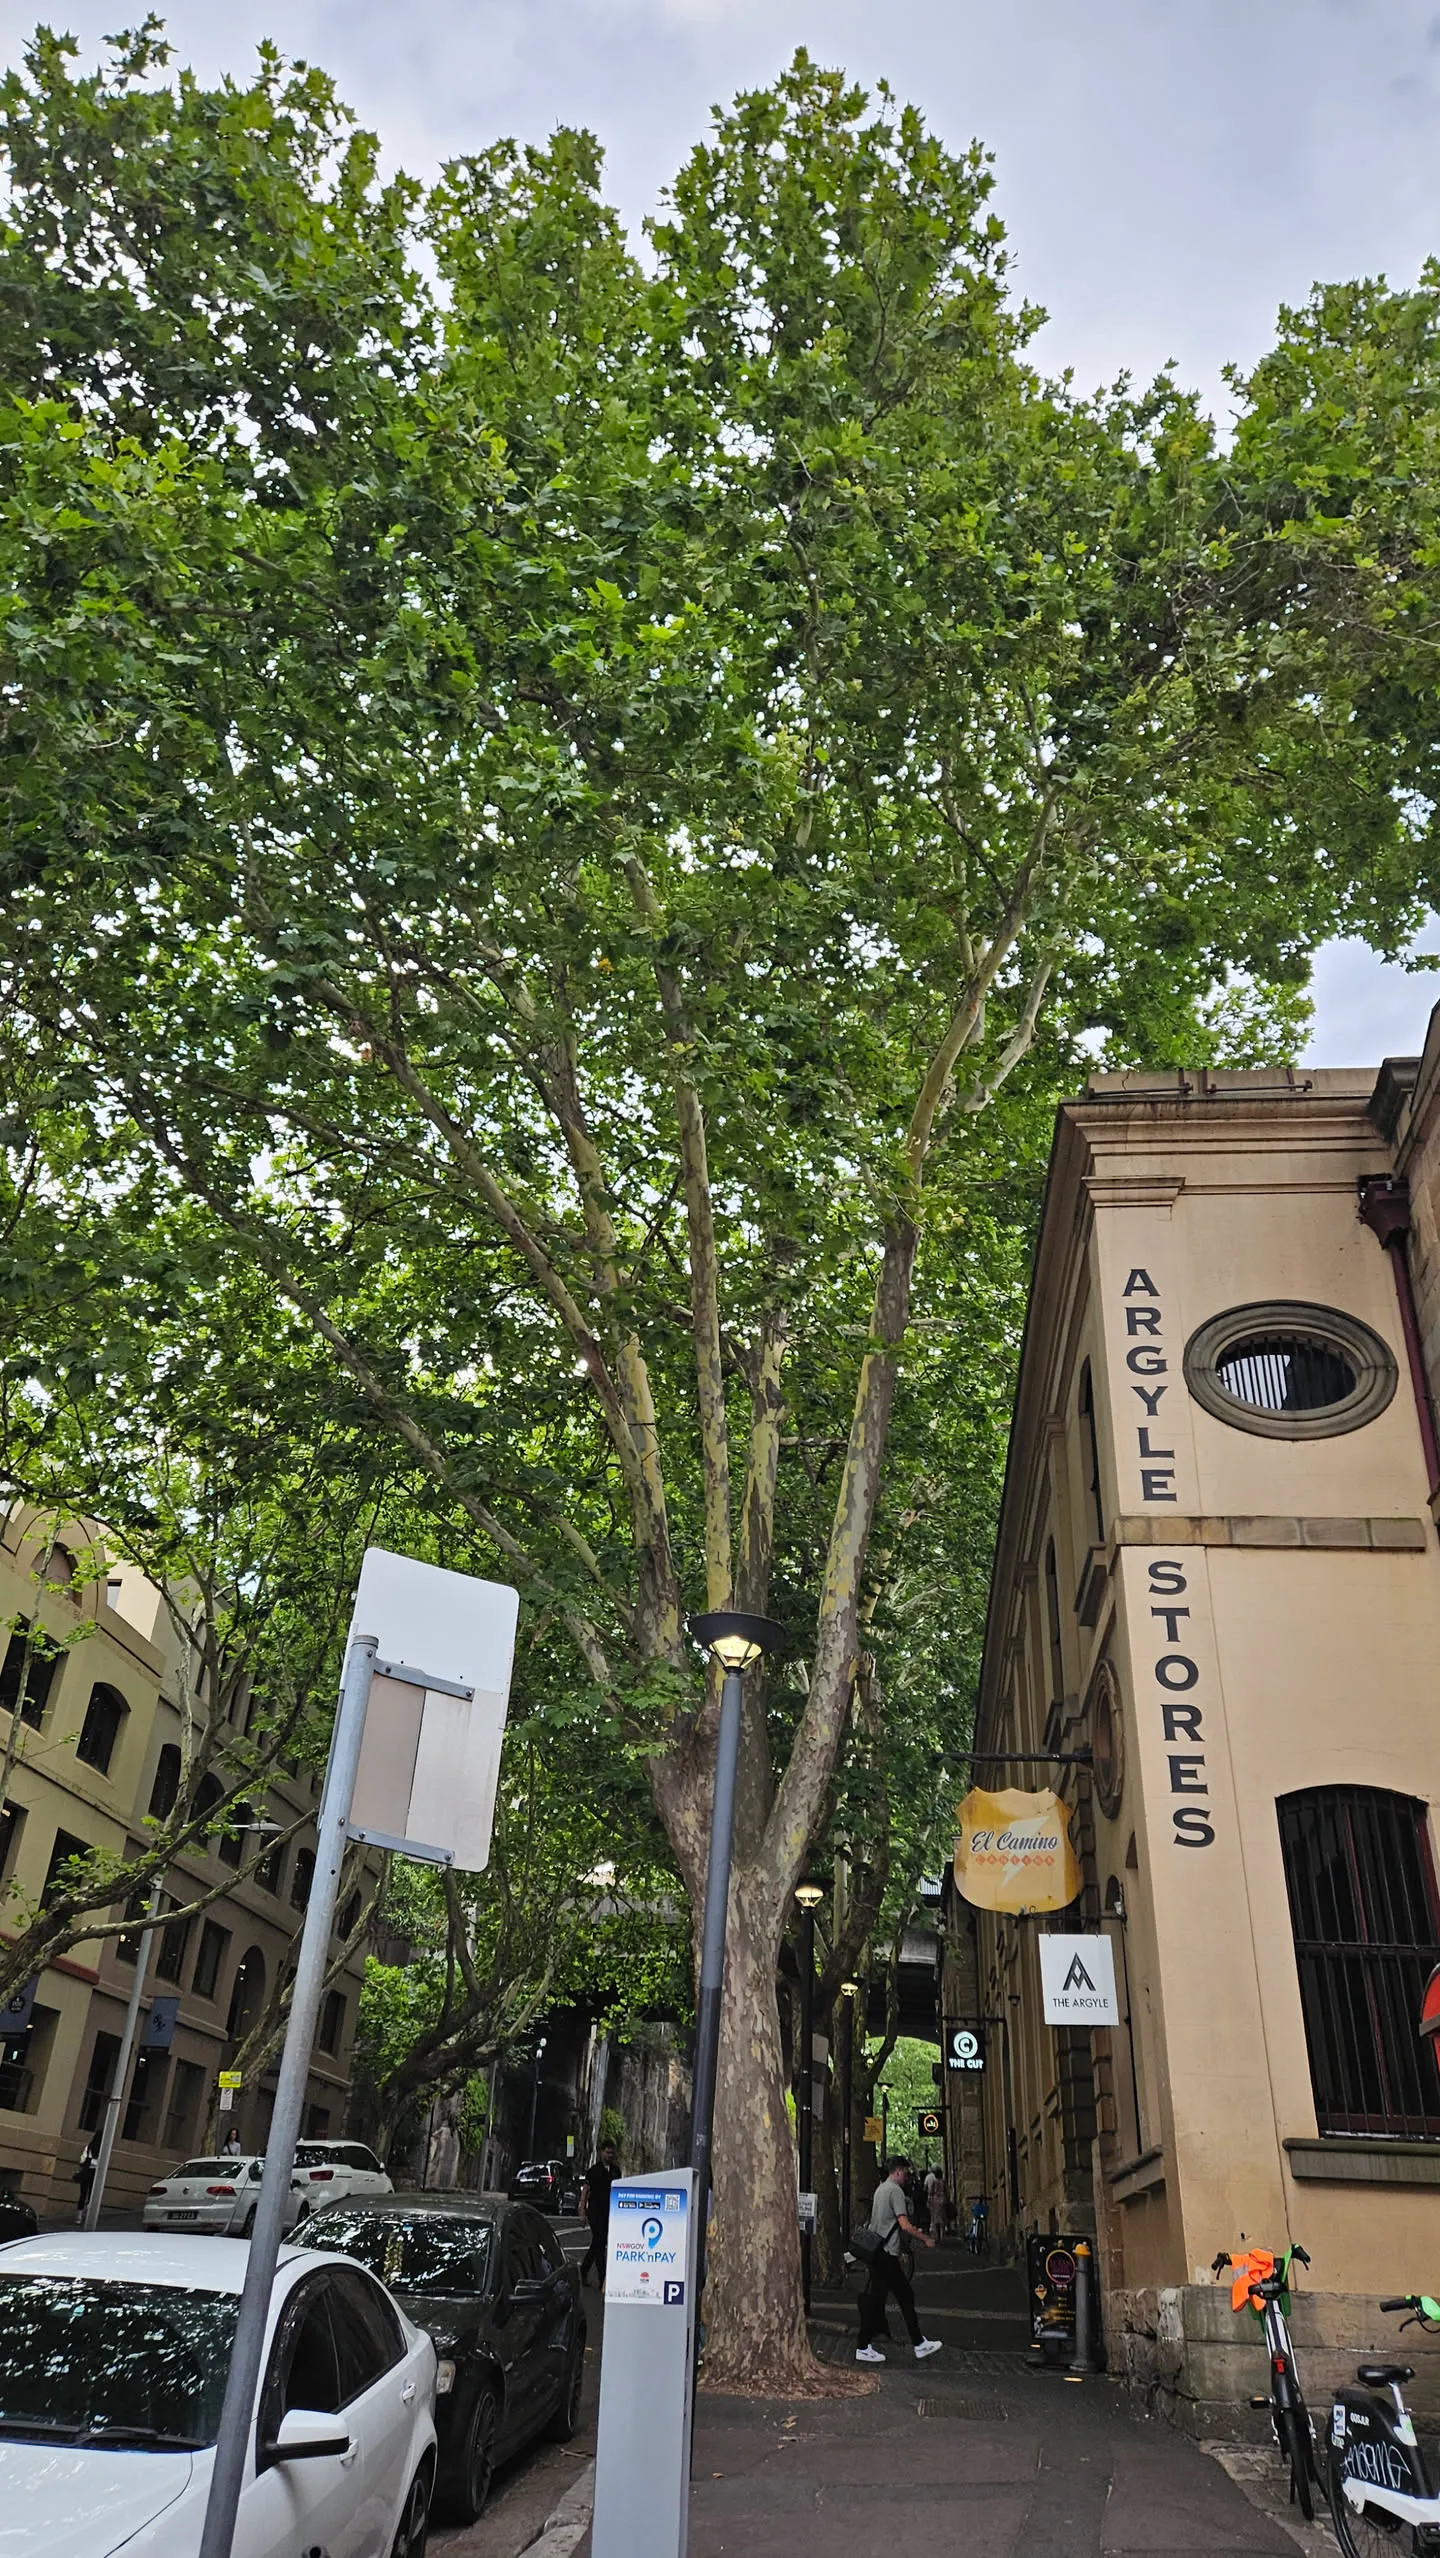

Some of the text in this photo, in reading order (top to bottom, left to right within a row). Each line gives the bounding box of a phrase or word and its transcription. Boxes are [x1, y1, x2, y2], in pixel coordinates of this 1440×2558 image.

[1121, 1268, 1216, 1849] ARGYLE STORES
[971, 1830, 1058, 1853] El Camino
[1052, 1998, 1109, 2009] THE ARGYLE
[949, 2058, 984, 2069] THE CUT
[616, 2242, 645, 2250] NSWGOV
[667, 2283, 681, 2302] P
